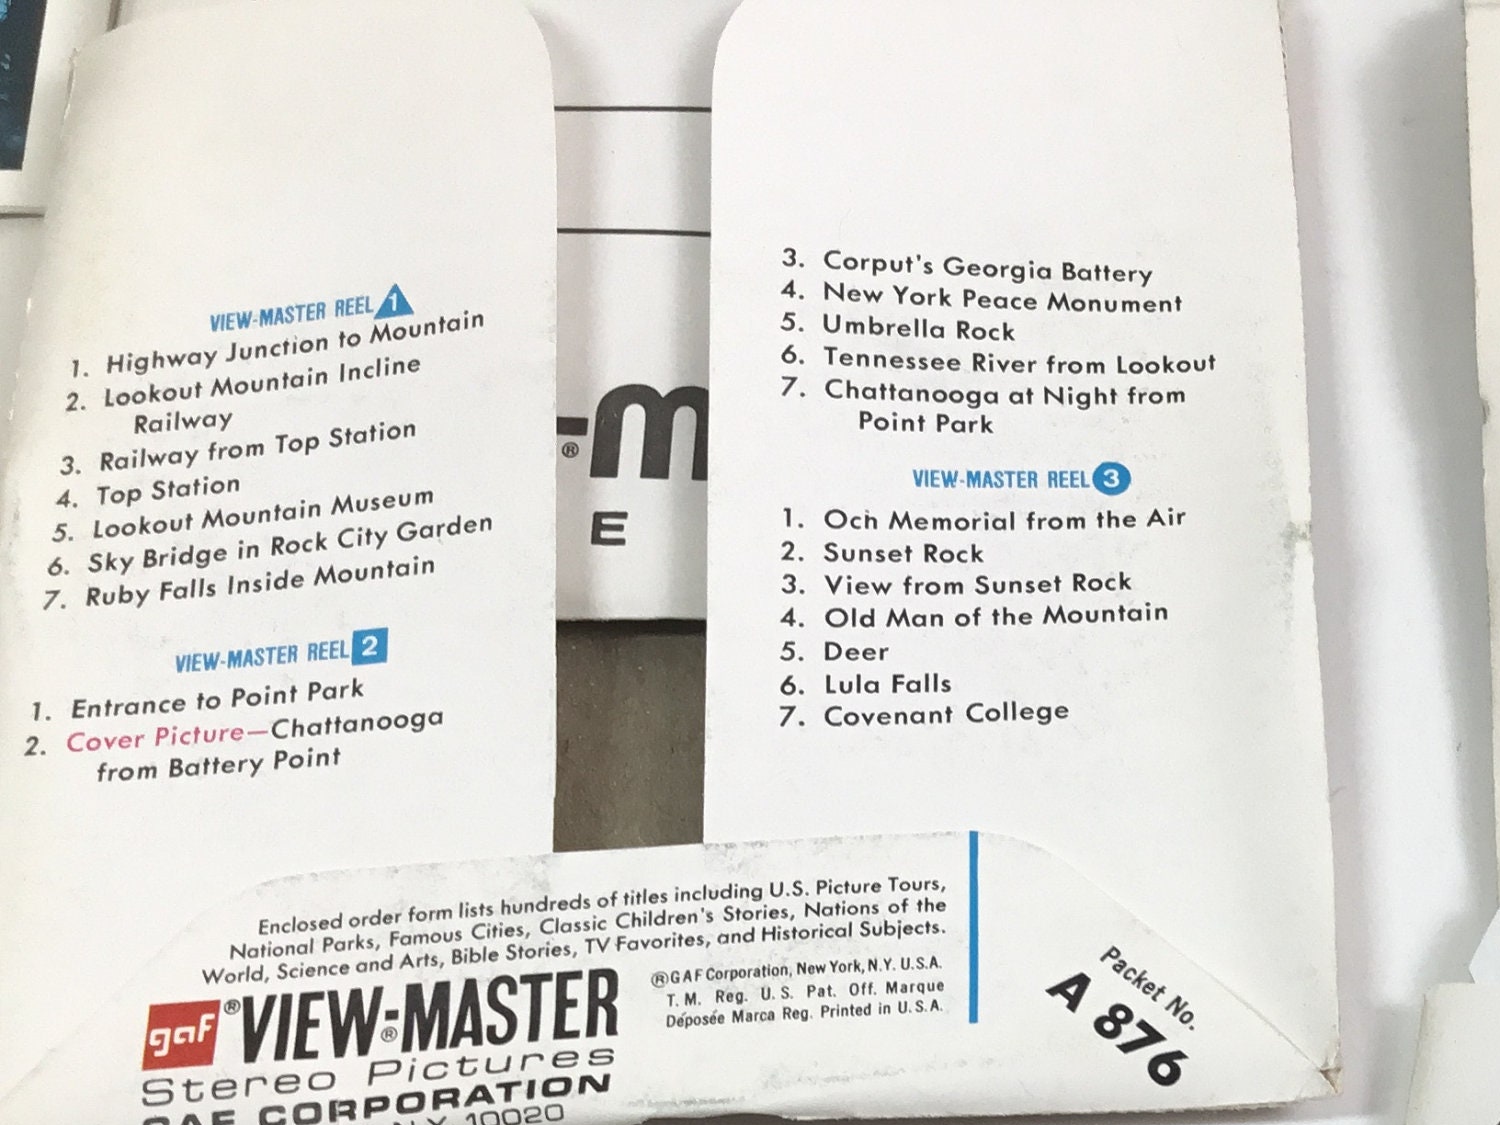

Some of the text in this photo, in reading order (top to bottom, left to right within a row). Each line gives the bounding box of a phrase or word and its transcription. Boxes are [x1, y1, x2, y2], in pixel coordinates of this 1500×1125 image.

[782, 247, 1153, 288] 3. Corput's Georgia Battery
[335, 296, 374, 317] REEL
[780, 312, 1015, 341] 5. Umbrella Rock
[72, 310, 484, 378] 1. Highway Junction to Mountain
[781, 344, 1216, 374] 6. Tennessee River from Lookout
[66, 357, 420, 412] 2. Lookout Mountain Incline
[1048, 470, 1090, 488] REEL
[47, 515, 492, 576] 6. Sky Bridge in Rock City Garden
[780, 641, 889, 661] 5. Deer
[780, 700, 1069, 727] 7. Covenant College
[259, 912, 343, 935] Enclosed
[348, 909, 402, 928] order
[408, 906, 452, 922] form
[459, 902, 494, 918] lists
[501, 893, 591, 915] hundreds
[597, 891, 618, 908] of
[623, 888, 668, 906] titles
[675, 883, 767, 908] including
[816, 879, 882, 895] Picture
[888, 876, 946, 893] Tours,
[1099, 945, 1199, 1031] Packet No.
[732, 1009, 775, 1023] Marca
[782, 1006, 814, 1022] Reg.
[821, 1003, 871, 1018] Printed
[878, 1002, 891, 1014] in
[1045, 971, 1189, 1087] A 876
[142, 1048, 614, 1107] Stereo Pictures
